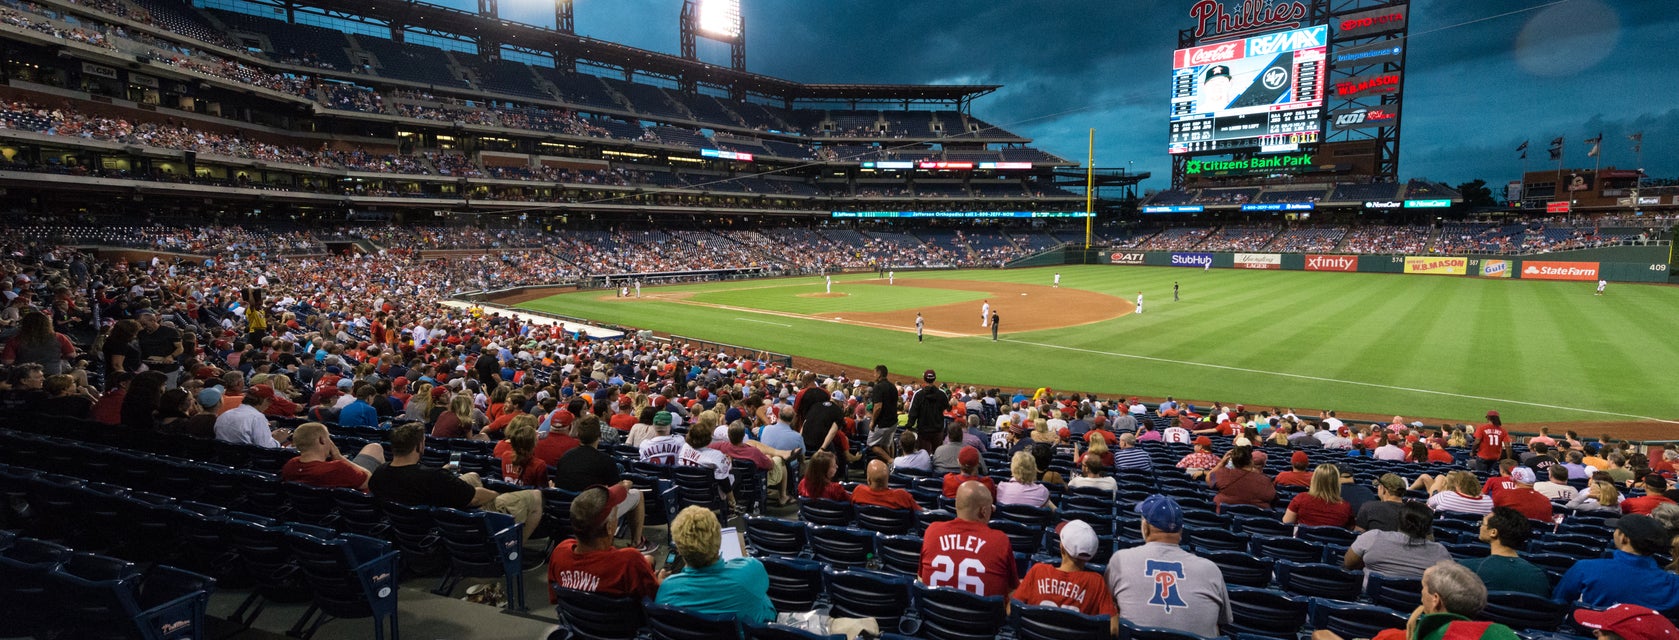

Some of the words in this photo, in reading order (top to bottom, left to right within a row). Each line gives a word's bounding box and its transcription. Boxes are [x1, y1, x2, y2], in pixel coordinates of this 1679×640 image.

[1190, 0, 1307, 38] Phillies
[1356, 13, 1403, 27] TOYOTA
[1250, 28, 1321, 56] RE/MAX
[1203, 160, 1249, 171] Citizens
[1250, 155, 1281, 168] Bank
[1283, 153, 1312, 166] Park
[1171, 254, 1212, 265] StubHub
[1308, 256, 1354, 270] xfinity
[1485, 263, 1506, 274] Gulf
[1173, 433, 1181, 442] 6
[1488, 434, 1499, 446] 11
[643, 443, 681, 458] HALLADAY
[1557, 490, 1572, 499] LEE
[939, 534, 986, 554] UTLEY
[560, 570, 600, 592] BROWN
[930, 554, 986, 597] 26
[1037, 577, 1087, 604] HERRERA
